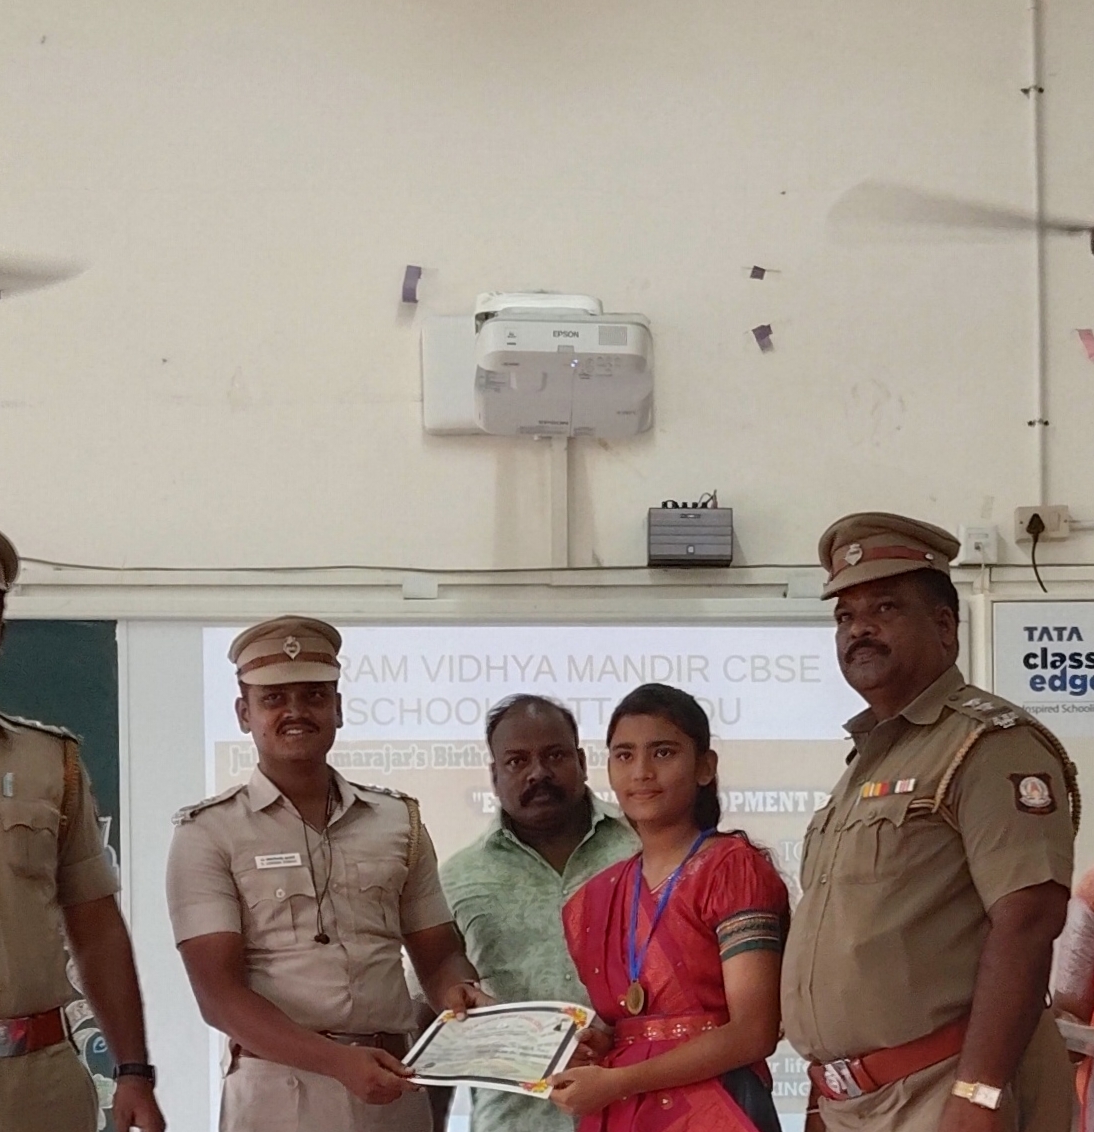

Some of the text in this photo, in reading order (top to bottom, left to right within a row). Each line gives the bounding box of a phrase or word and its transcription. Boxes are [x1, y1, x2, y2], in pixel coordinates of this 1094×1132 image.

[552, 330, 579, 338] EPSON
[1023, 626, 1084, 642] TATA
[420, 654, 558, 683] VIDHYA
[566, 654, 710, 683] MANDIR
[722, 654, 822, 683] CBSE
[1029, 664, 1094, 696] edg
[333, 744, 427, 774] marajar's
